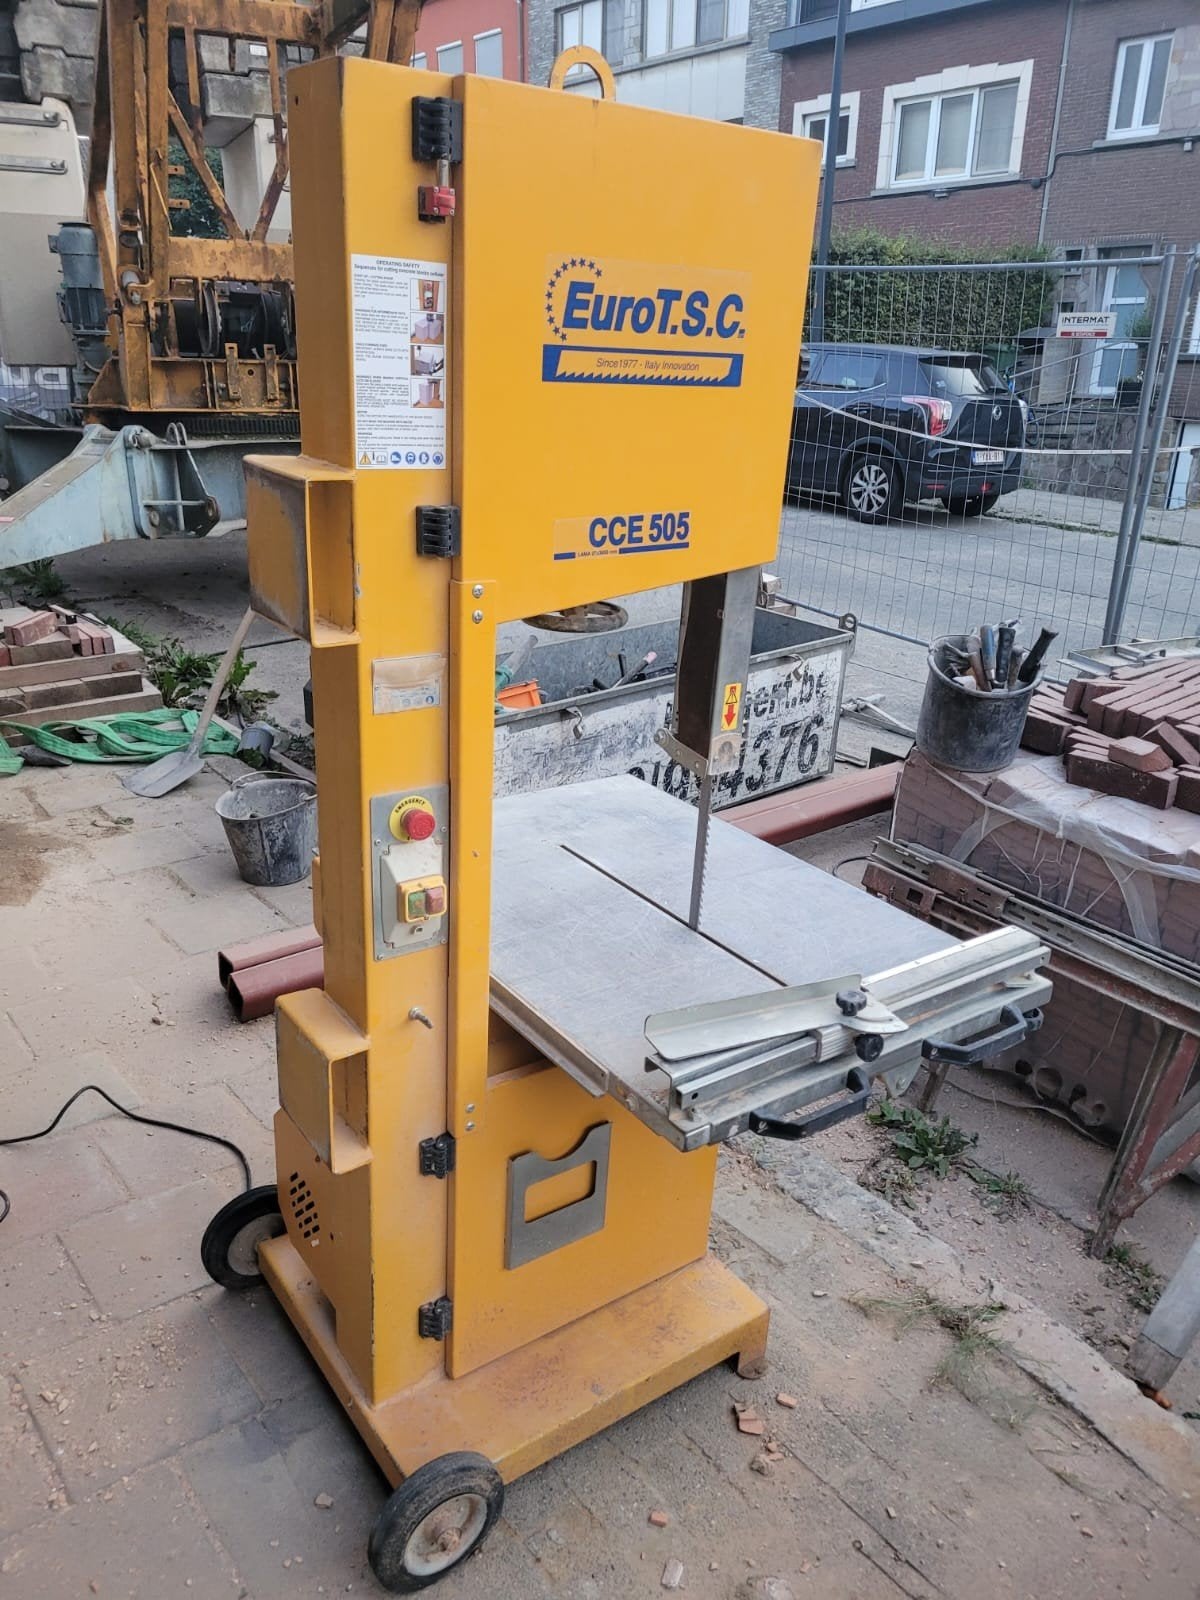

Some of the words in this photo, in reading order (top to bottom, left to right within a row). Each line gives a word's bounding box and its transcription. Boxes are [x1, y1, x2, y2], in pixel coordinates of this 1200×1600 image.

[1062, 316, 1110, 324] INTERMAT
[644, 360, 660, 371] Italy
[662, 361, 699, 371] Innovation
[589, 515, 644, 547] CCE
[649, 512, 690, 542] 505
[395, 798, 425, 813] EMERGENCY
